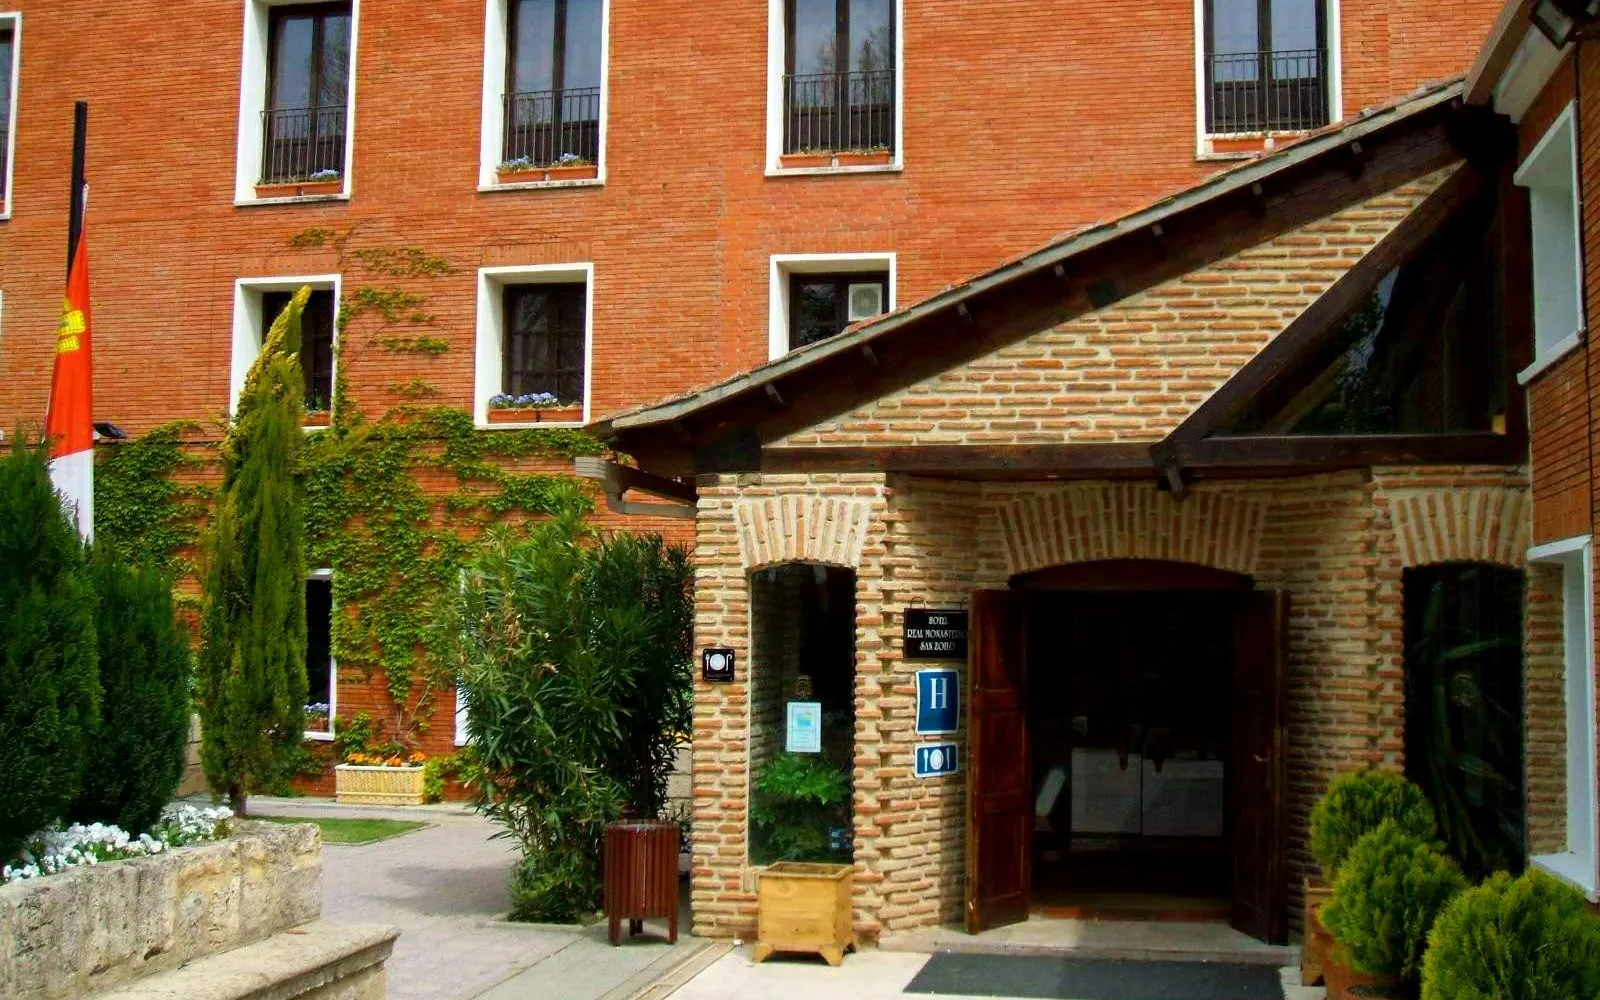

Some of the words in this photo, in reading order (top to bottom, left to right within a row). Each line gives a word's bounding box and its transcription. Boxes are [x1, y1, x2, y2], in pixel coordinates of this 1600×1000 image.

[928, 616, 948, 625] HOTEL
[907, 629, 923, 638] REAL
[920, 641, 933, 651] SAN
[929, 677, 948, 710] H
